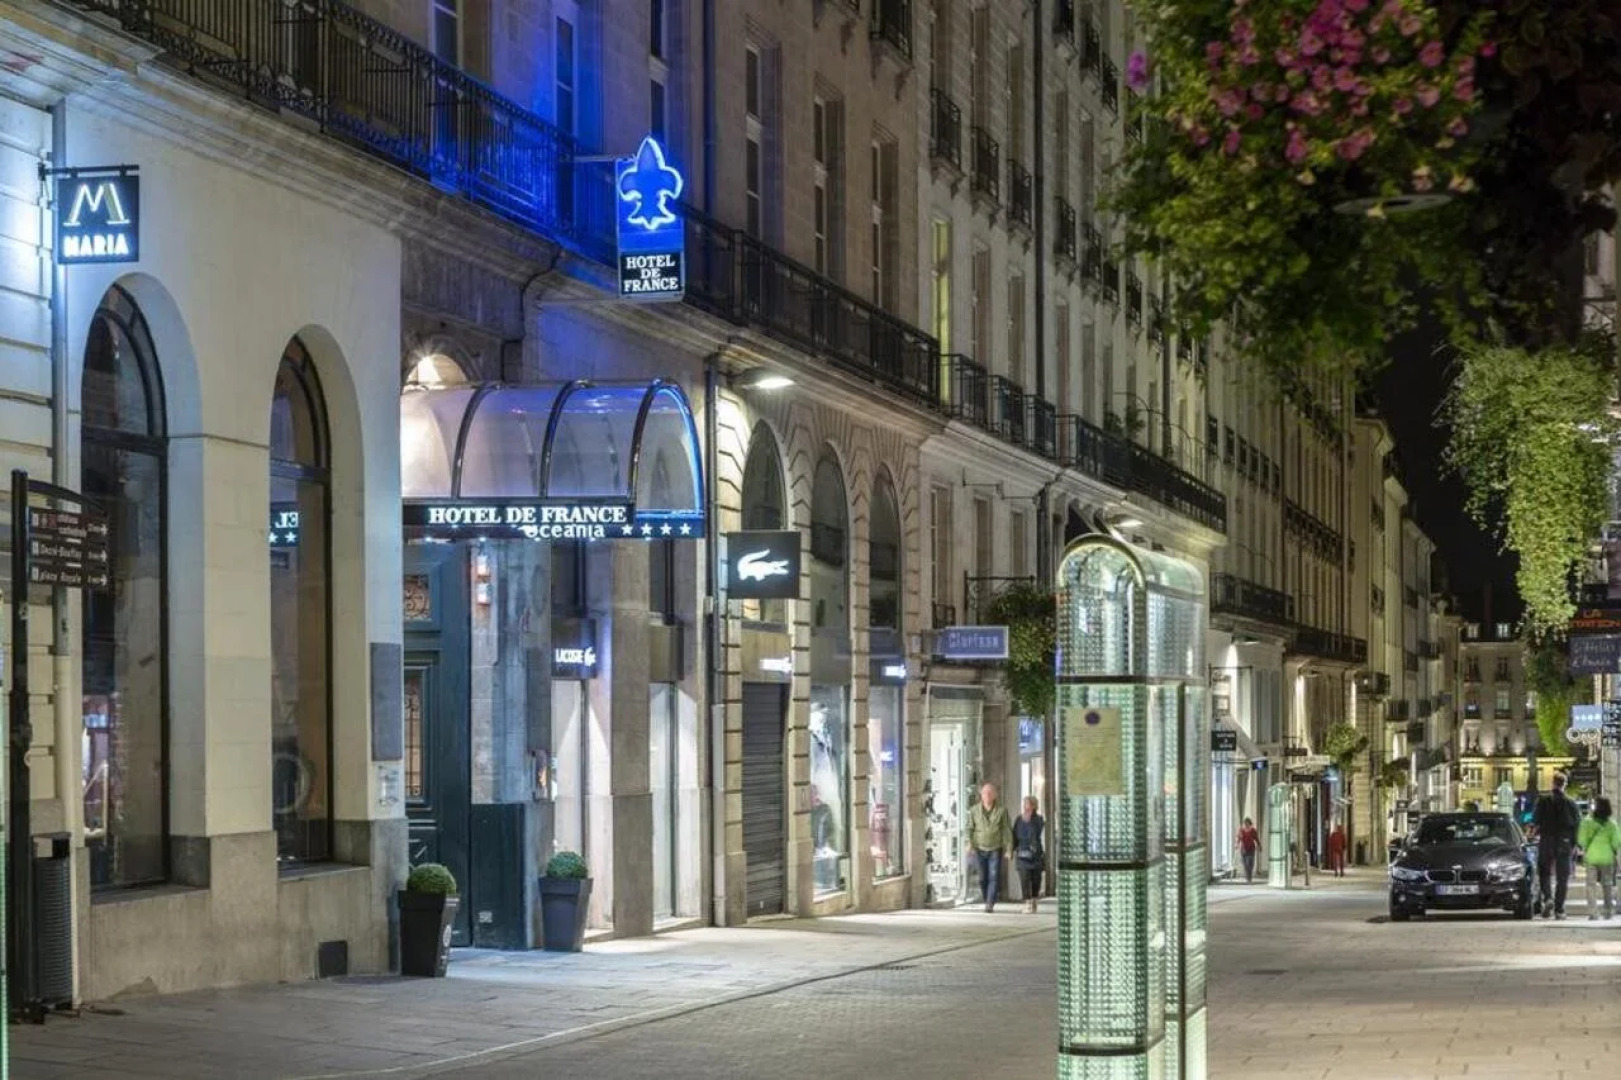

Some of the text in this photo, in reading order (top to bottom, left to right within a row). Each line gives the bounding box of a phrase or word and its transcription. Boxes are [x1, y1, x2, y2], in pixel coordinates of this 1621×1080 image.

[63, 233, 129, 257] MARIA
[626, 254, 676, 270] HOTEL
[641, 268, 661, 279] DE
[623, 277, 679, 293] FRANCE
[428, 505, 627, 524] HOTEL DE FRANCE
